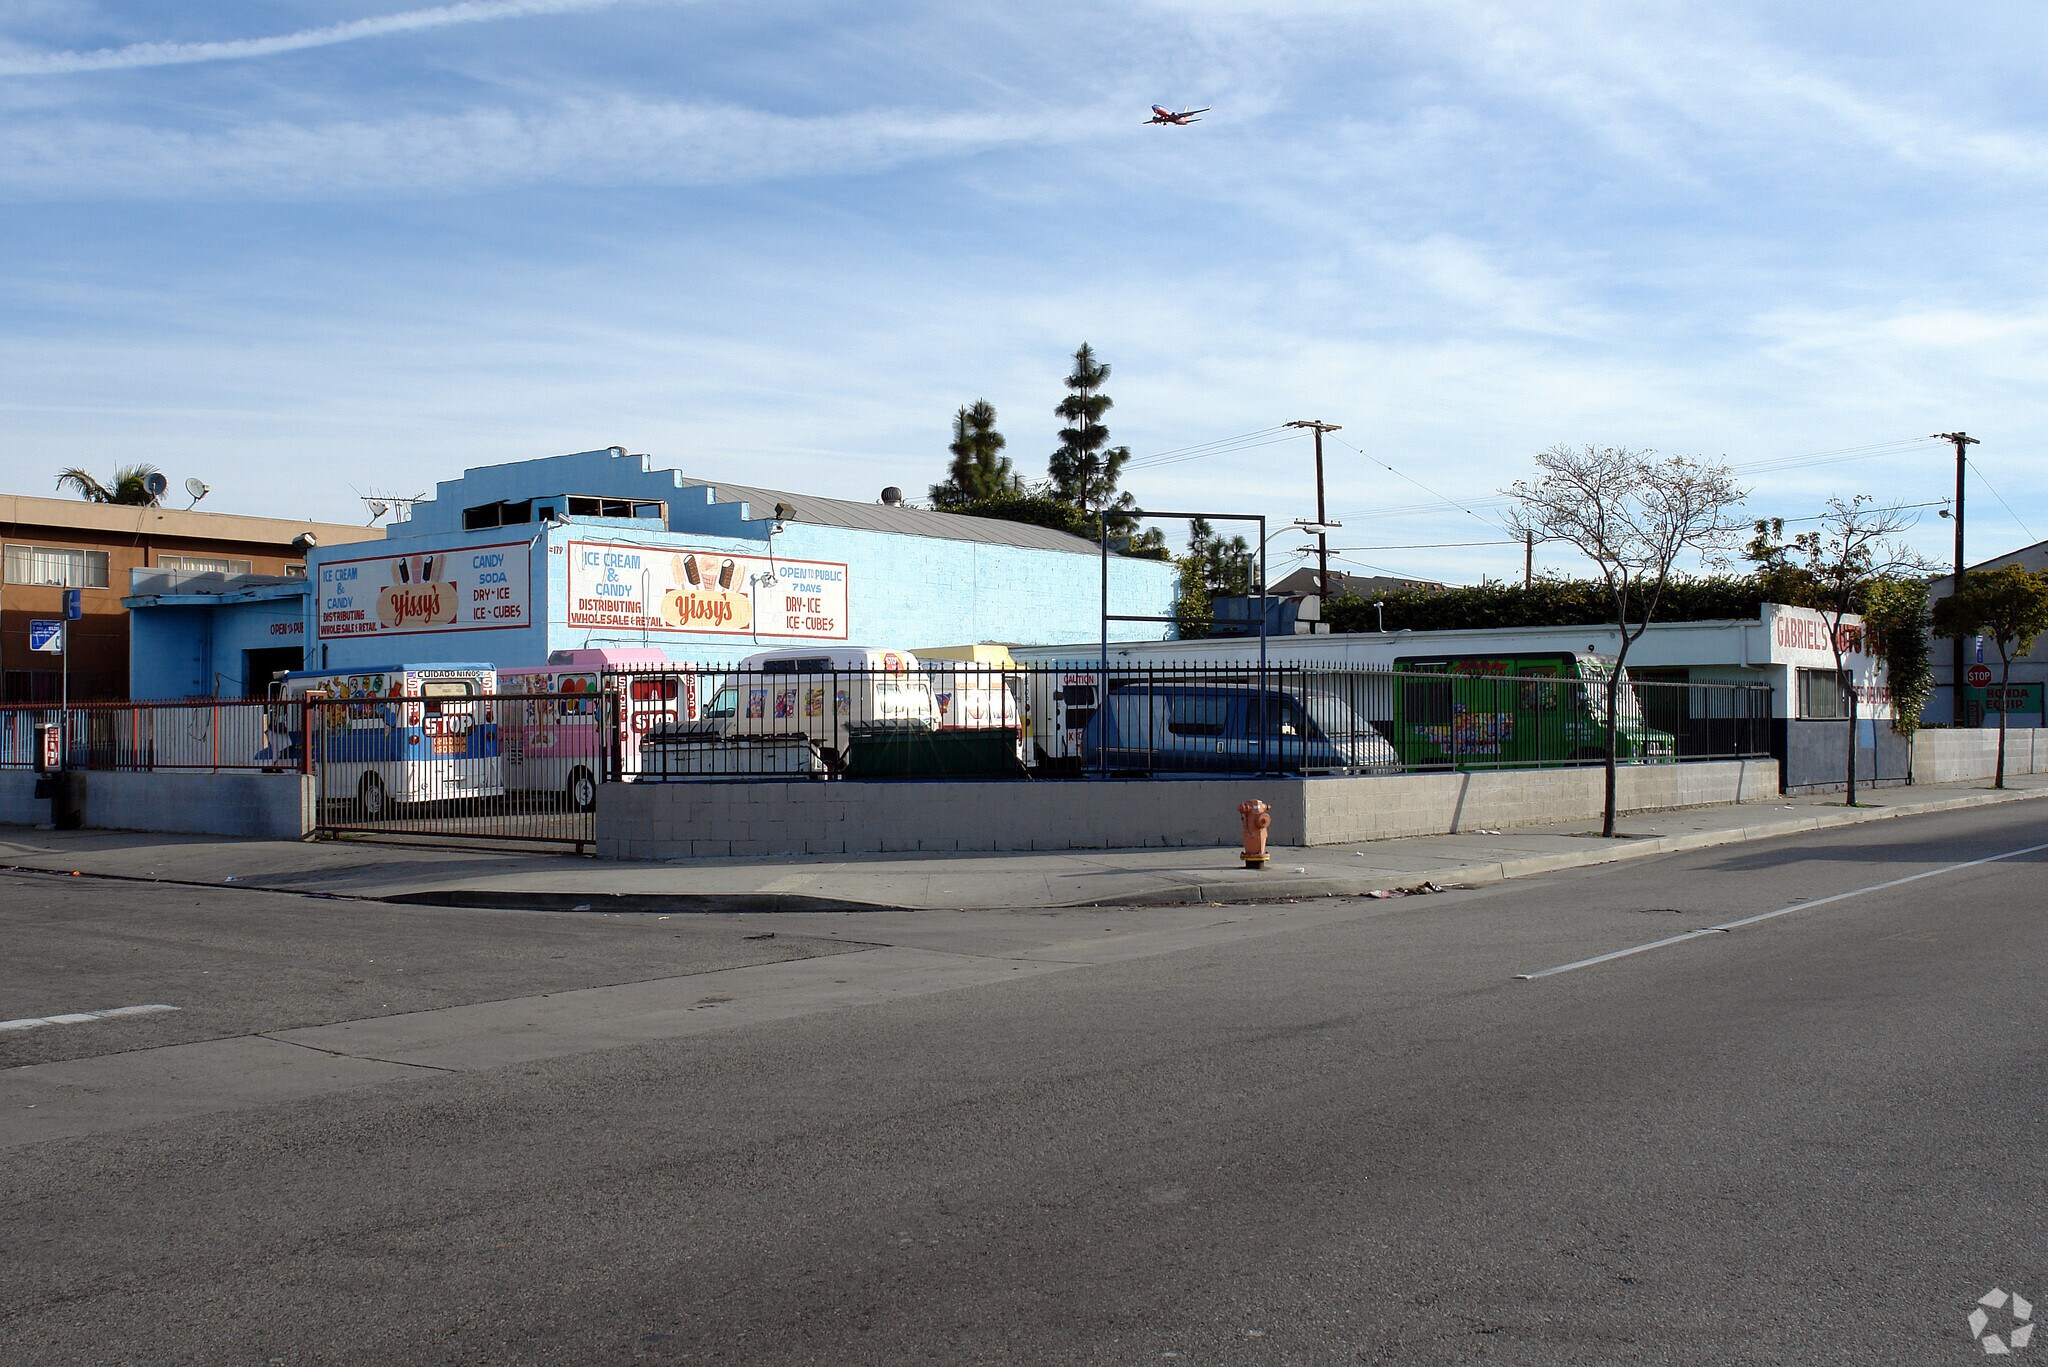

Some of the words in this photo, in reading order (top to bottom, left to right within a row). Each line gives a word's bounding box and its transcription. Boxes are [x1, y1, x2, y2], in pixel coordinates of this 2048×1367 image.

[472, 553, 504, 570] CANDY
[584, 551, 600, 567] ICE
[603, 552, 641, 571] CREAM
[323, 568, 333, 583] ICE
[335, 566, 358, 582] CREAM
[478, 571, 508, 586] SODA
[606, 568, 620, 583] &
[779, 566, 807, 580] OPEN
[807, 569, 815, 580] TO
[814, 569, 843, 582] PUBLIC
[336, 582, 345, 595] &
[595, 582, 633, 598] CANDY
[792, 583, 799, 592] 7
[799, 583, 822, 594] DAYS
[327, 596, 355, 610] CANDY
[578, 598, 642, 615] DISTRIBUTING
[323, 609, 365, 623] DISTRIBUTING
[571, 612, 631, 627] WHOLESALE
[635, 615, 664, 628] RETAIL
[270, 622, 287, 635] OPEN
[358, 621, 377, 633] RETAIL
[1776, 616, 1828, 651] GABRIEL'S
[417, 670, 456, 678] CUIDADO
[1063, 674, 1095, 685] CAUTION
[1968, 671, 1991, 682] STOP
[425, 712, 473, 736] STOP
